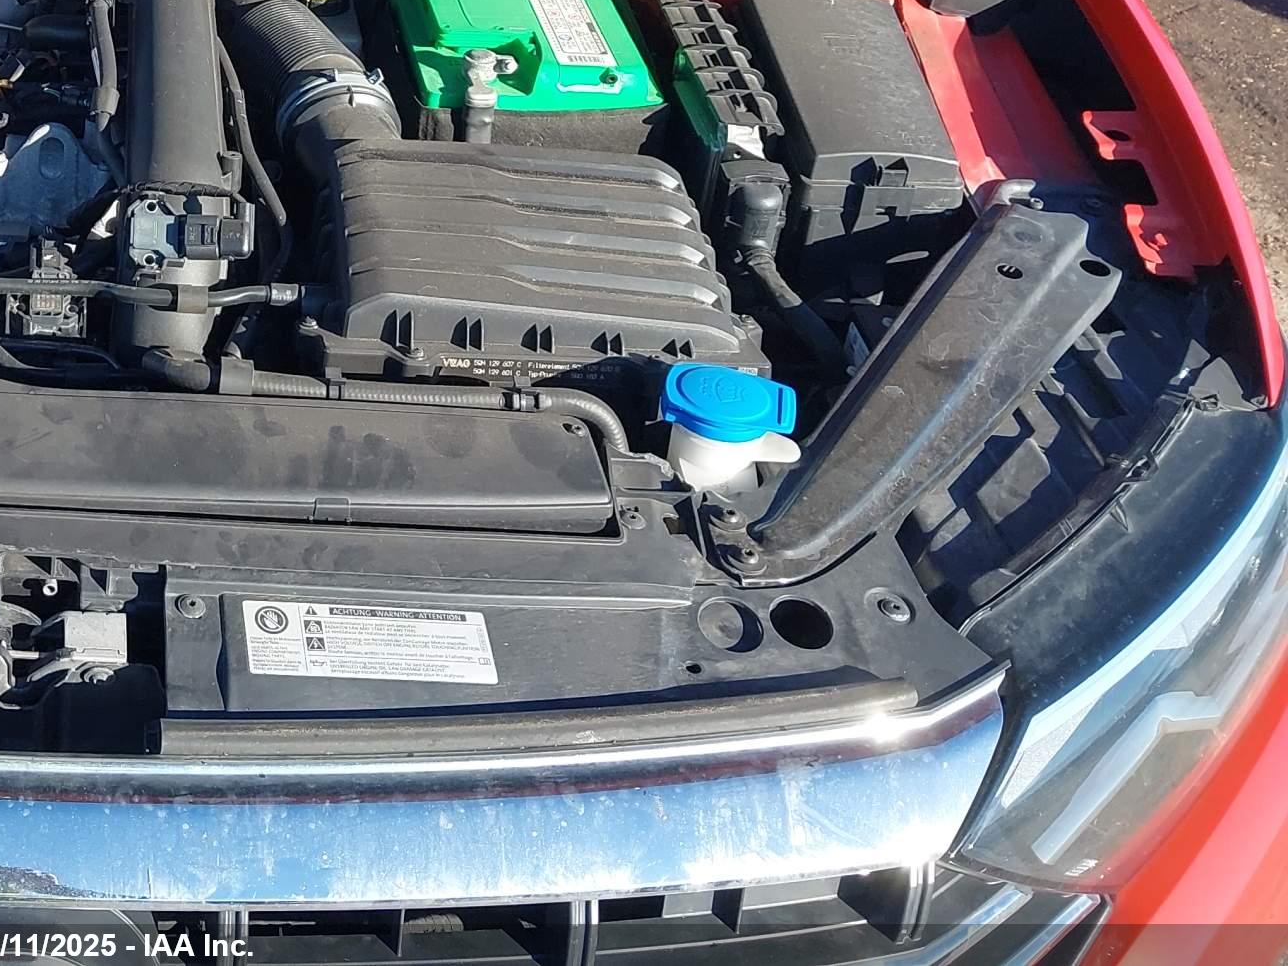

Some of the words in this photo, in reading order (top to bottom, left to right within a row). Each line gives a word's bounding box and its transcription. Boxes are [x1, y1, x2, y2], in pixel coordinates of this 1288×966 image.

[332, 607, 372, 617] ACHTUNG
[376, 610, 414, 619] WARNING
[418, 612, 462, 621] ATTENTION
